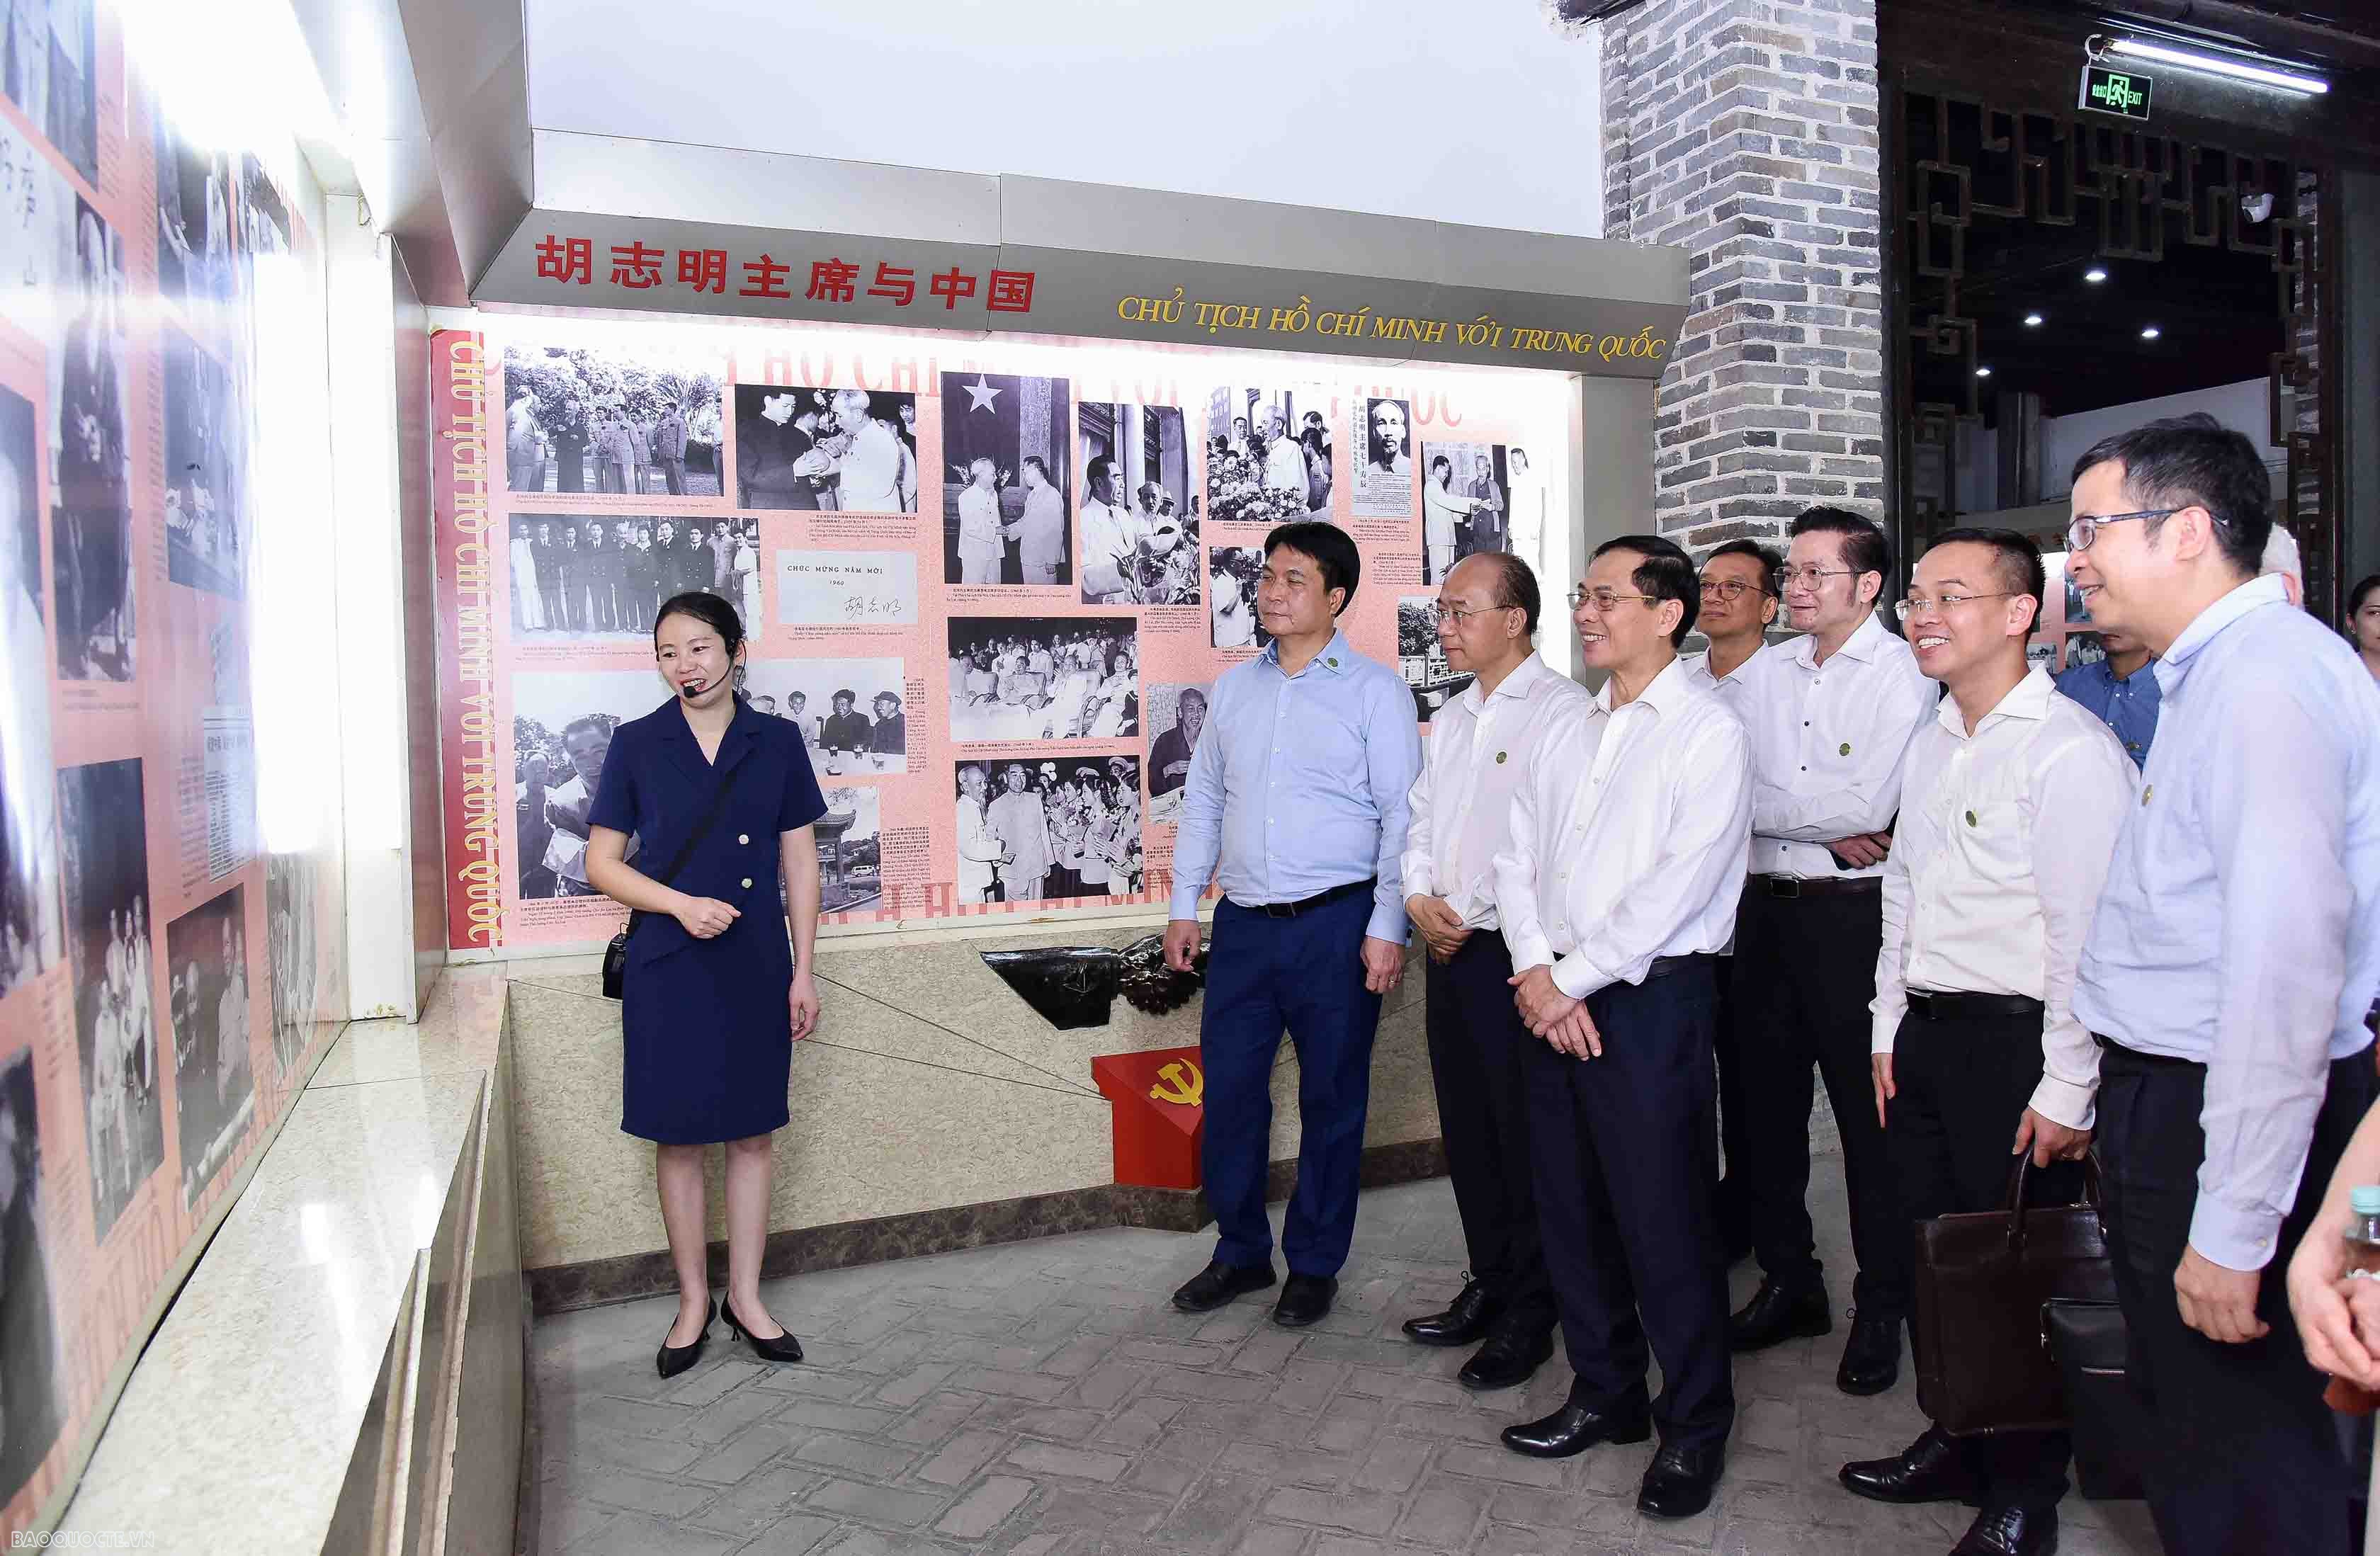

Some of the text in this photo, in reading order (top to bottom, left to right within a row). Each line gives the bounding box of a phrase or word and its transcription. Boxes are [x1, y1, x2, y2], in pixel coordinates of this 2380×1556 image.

[2128, 91, 2143, 106] EXIT
[536, 234, 1035, 312] 胡志明主席与中国
[1118, 288, 1667, 363] CHỦ TỊCH HỒ CHÍ MINH VỚI TRUNG QUỐC
[457, 606, 492, 682] MINH
[461, 751, 499, 853] TRUNG
